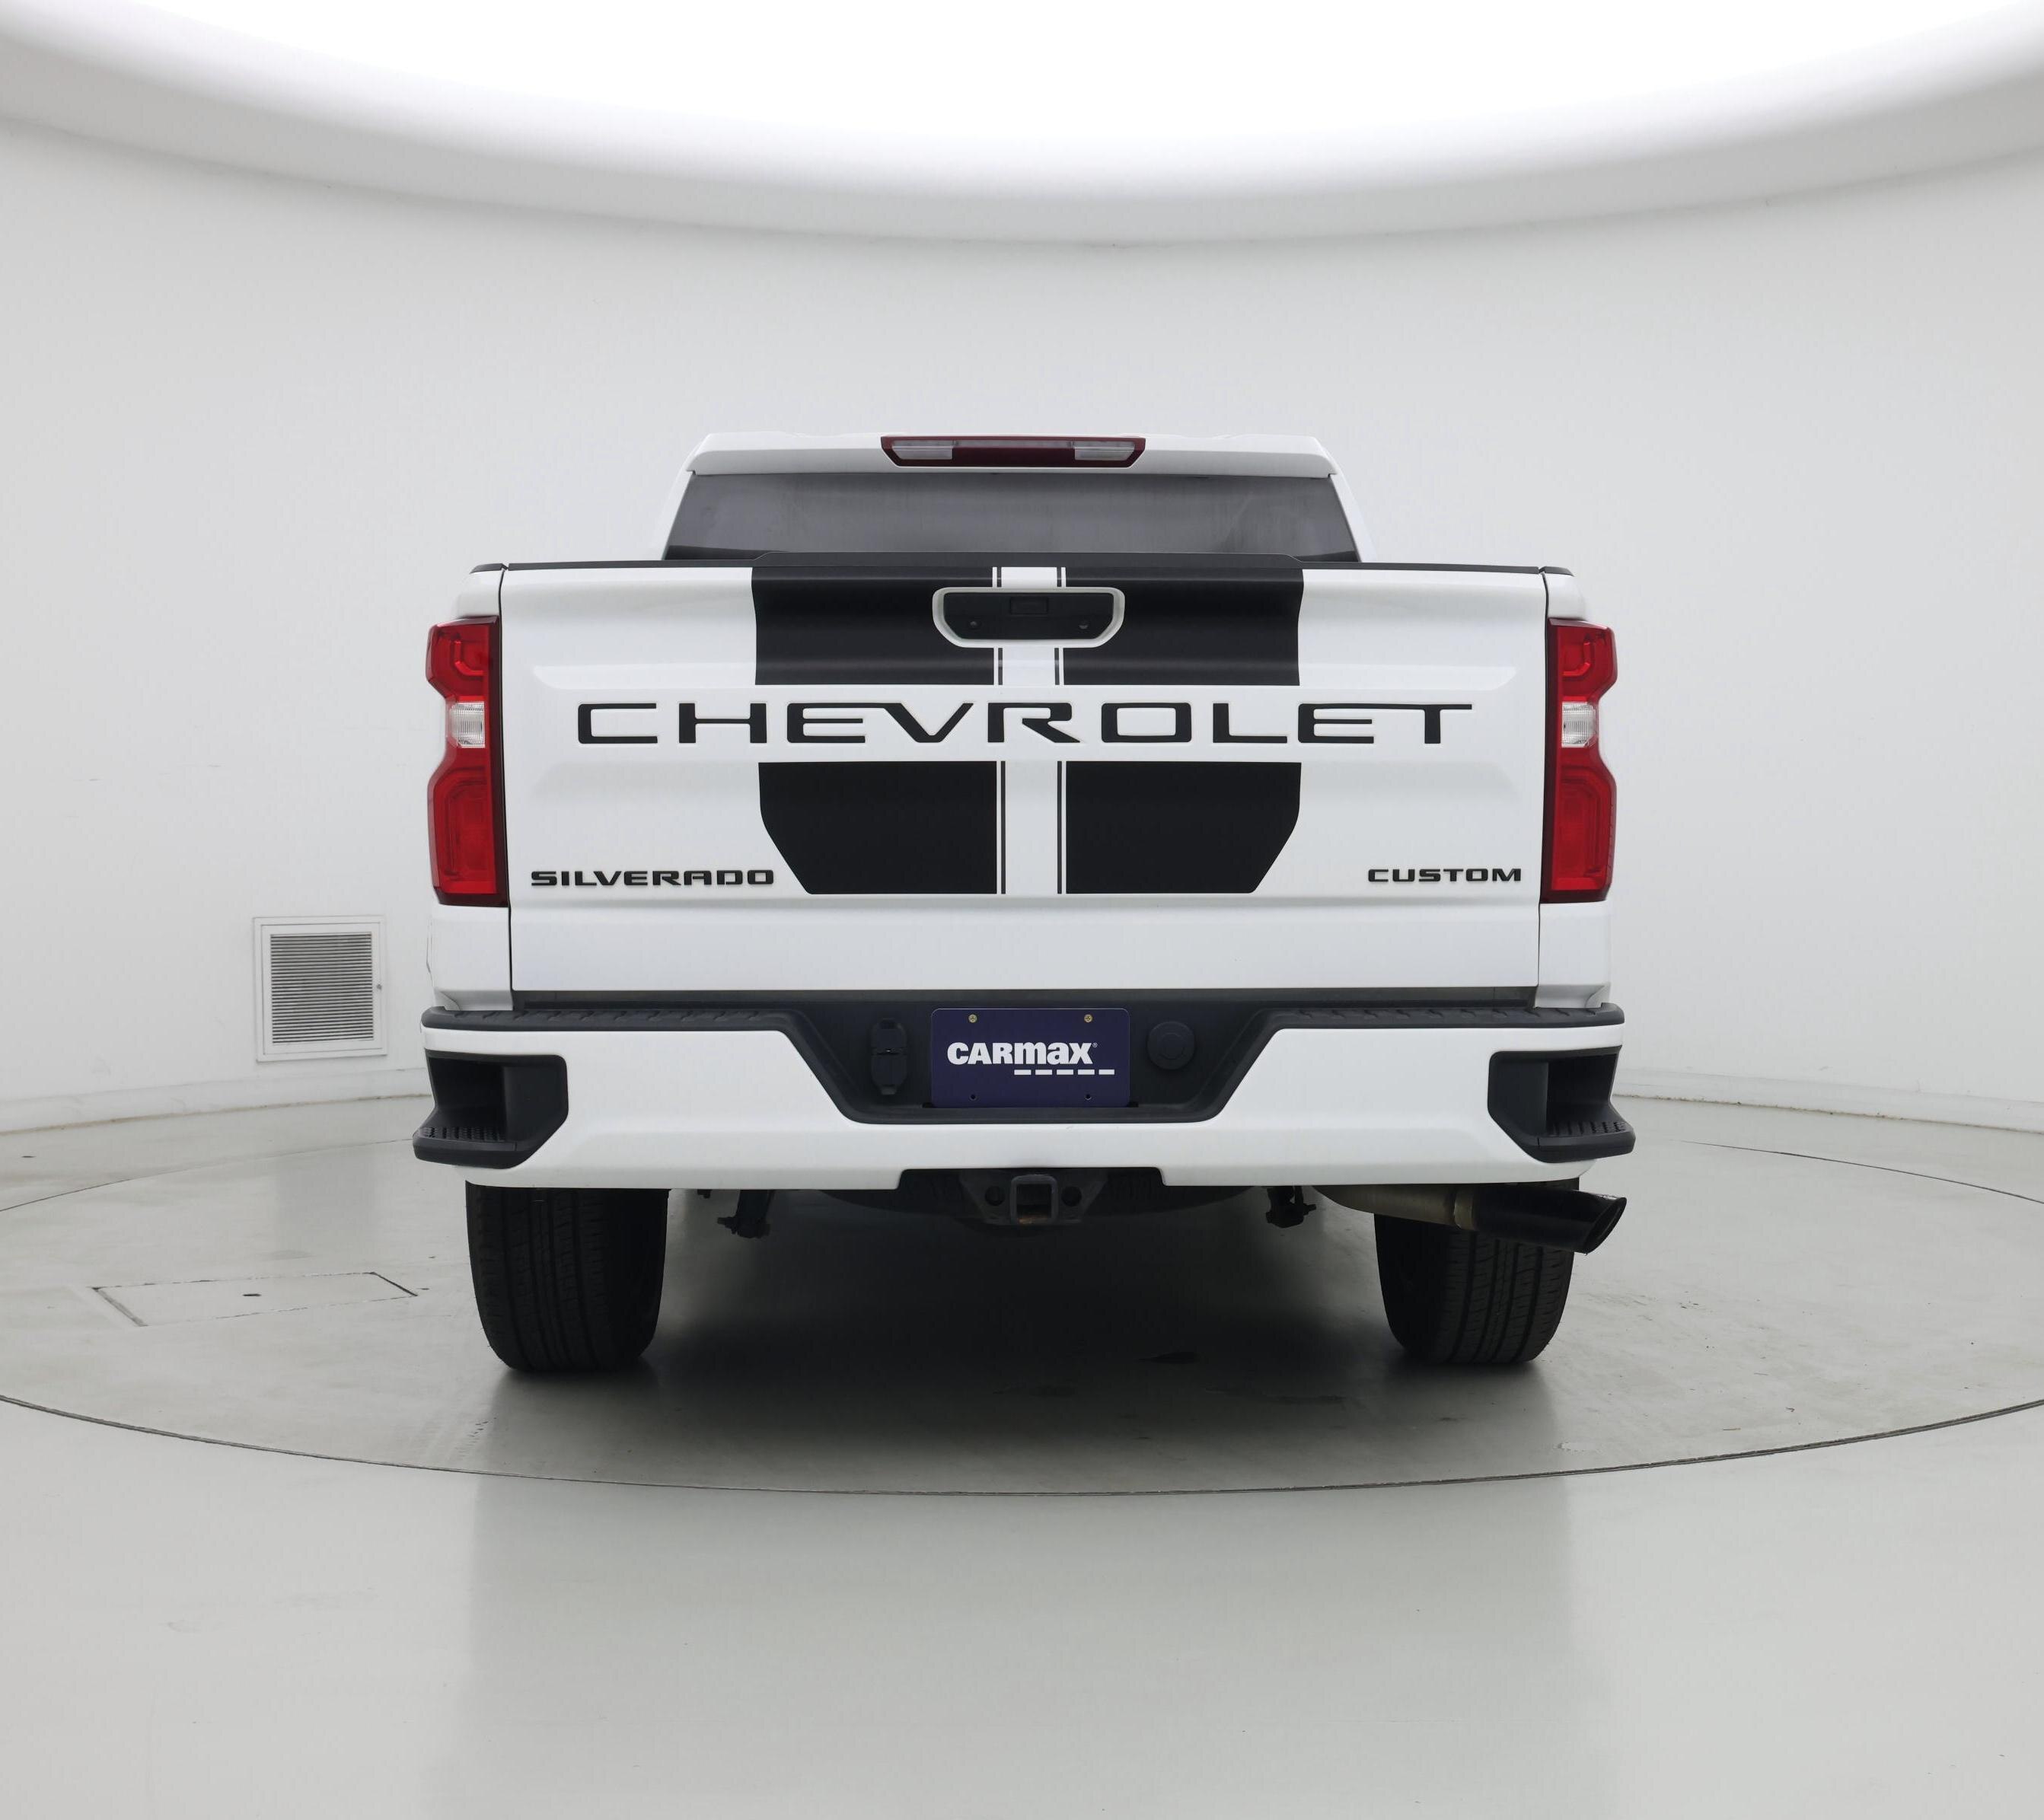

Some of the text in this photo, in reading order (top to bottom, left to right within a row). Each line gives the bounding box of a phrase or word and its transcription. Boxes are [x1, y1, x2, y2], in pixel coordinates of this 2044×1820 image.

[577, 702, 1472, 744] CHEVROLET
[530, 869, 774, 887] SILVERADO
[1367, 868, 1522, 882] CUSTOM
